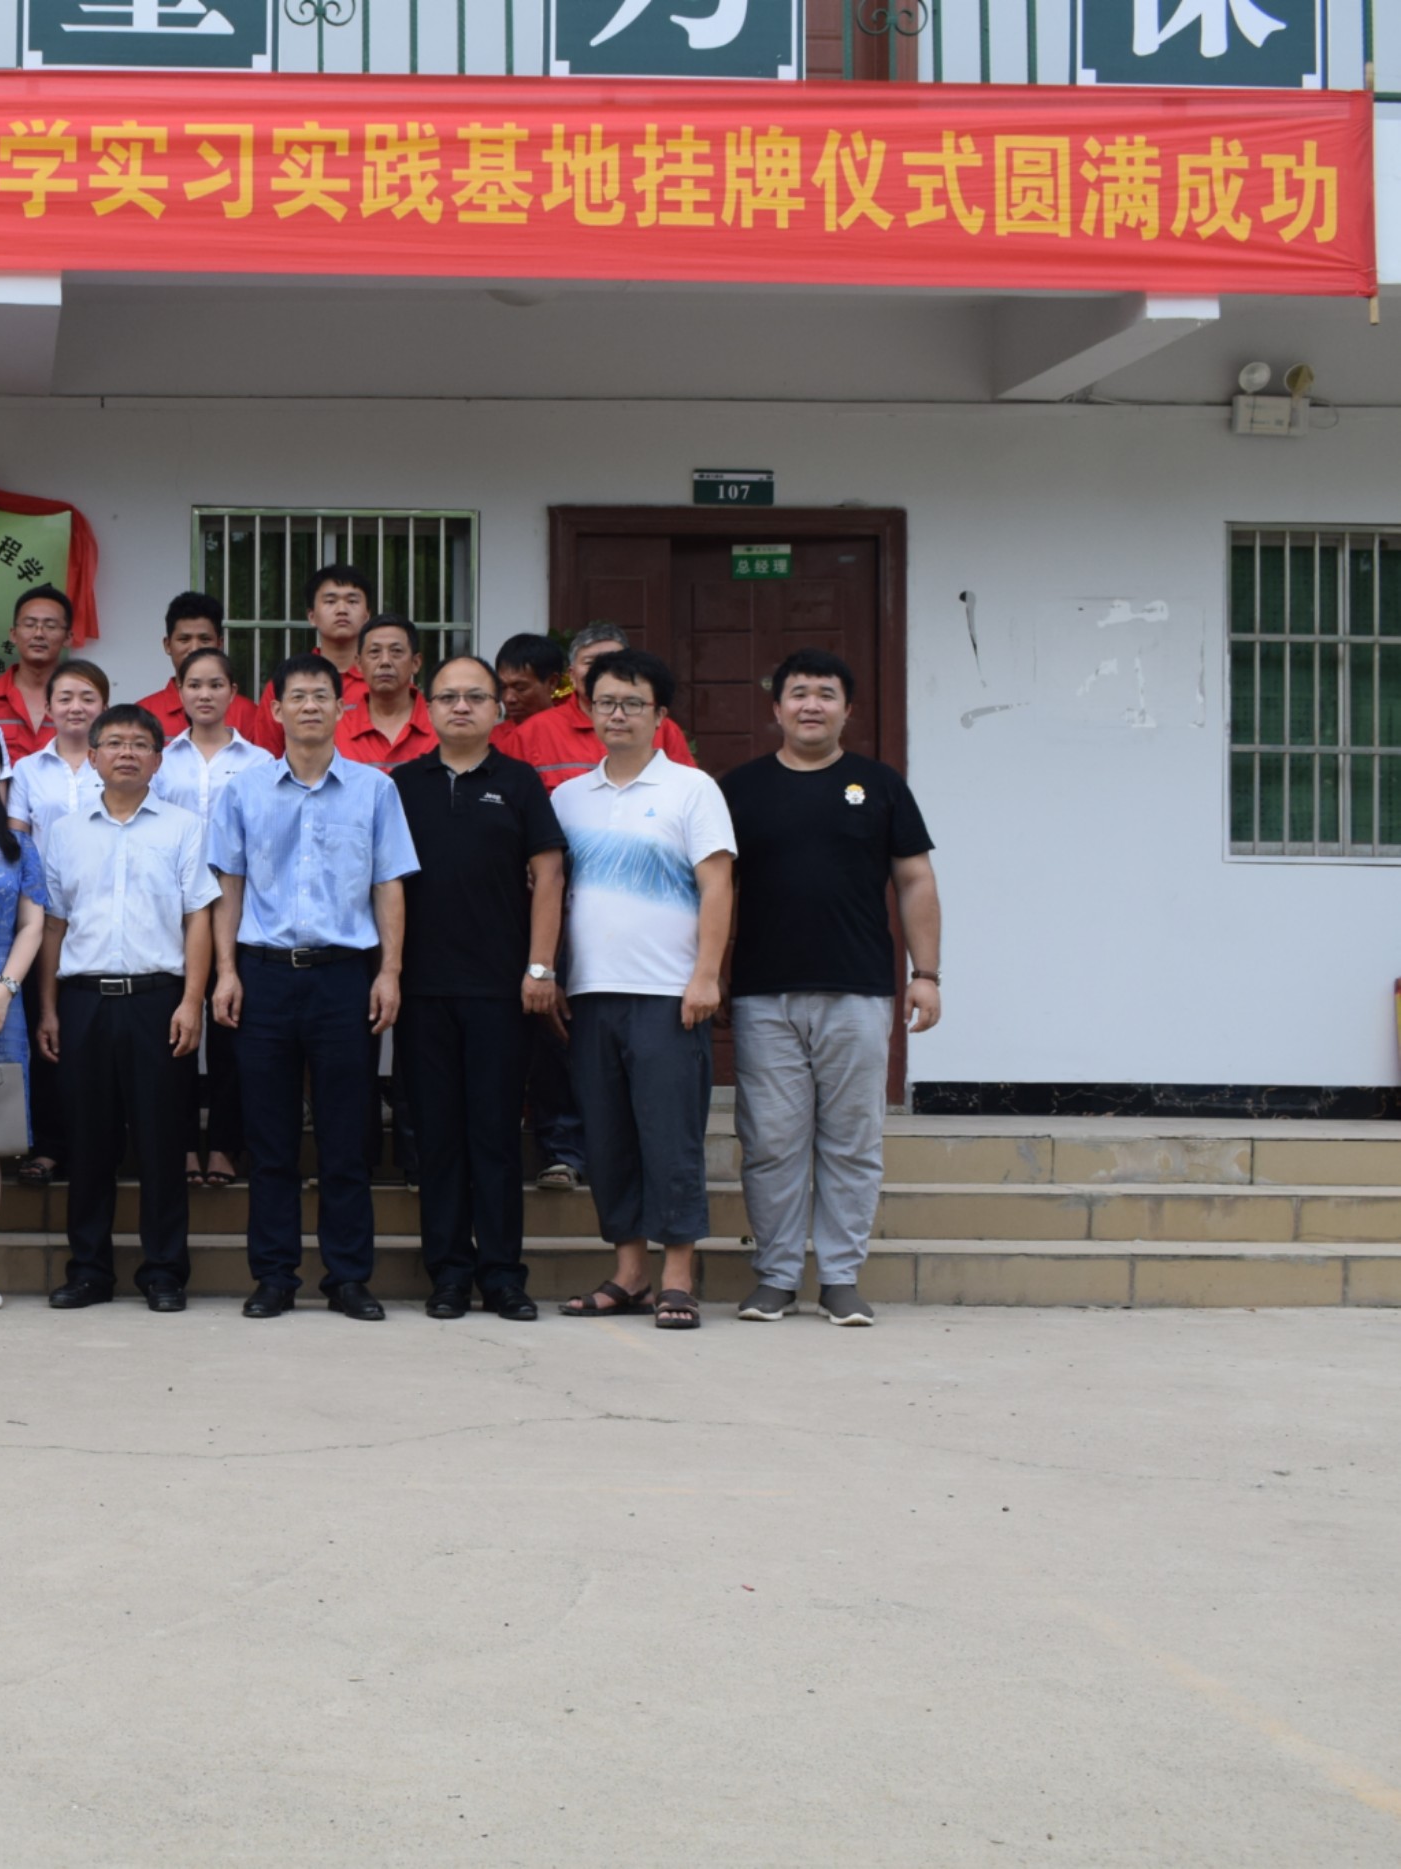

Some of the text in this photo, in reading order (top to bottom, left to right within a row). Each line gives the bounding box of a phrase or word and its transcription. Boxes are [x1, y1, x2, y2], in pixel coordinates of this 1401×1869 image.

[717, 484, 751, 500] 107
[736, 559, 788, 574] 总经理
